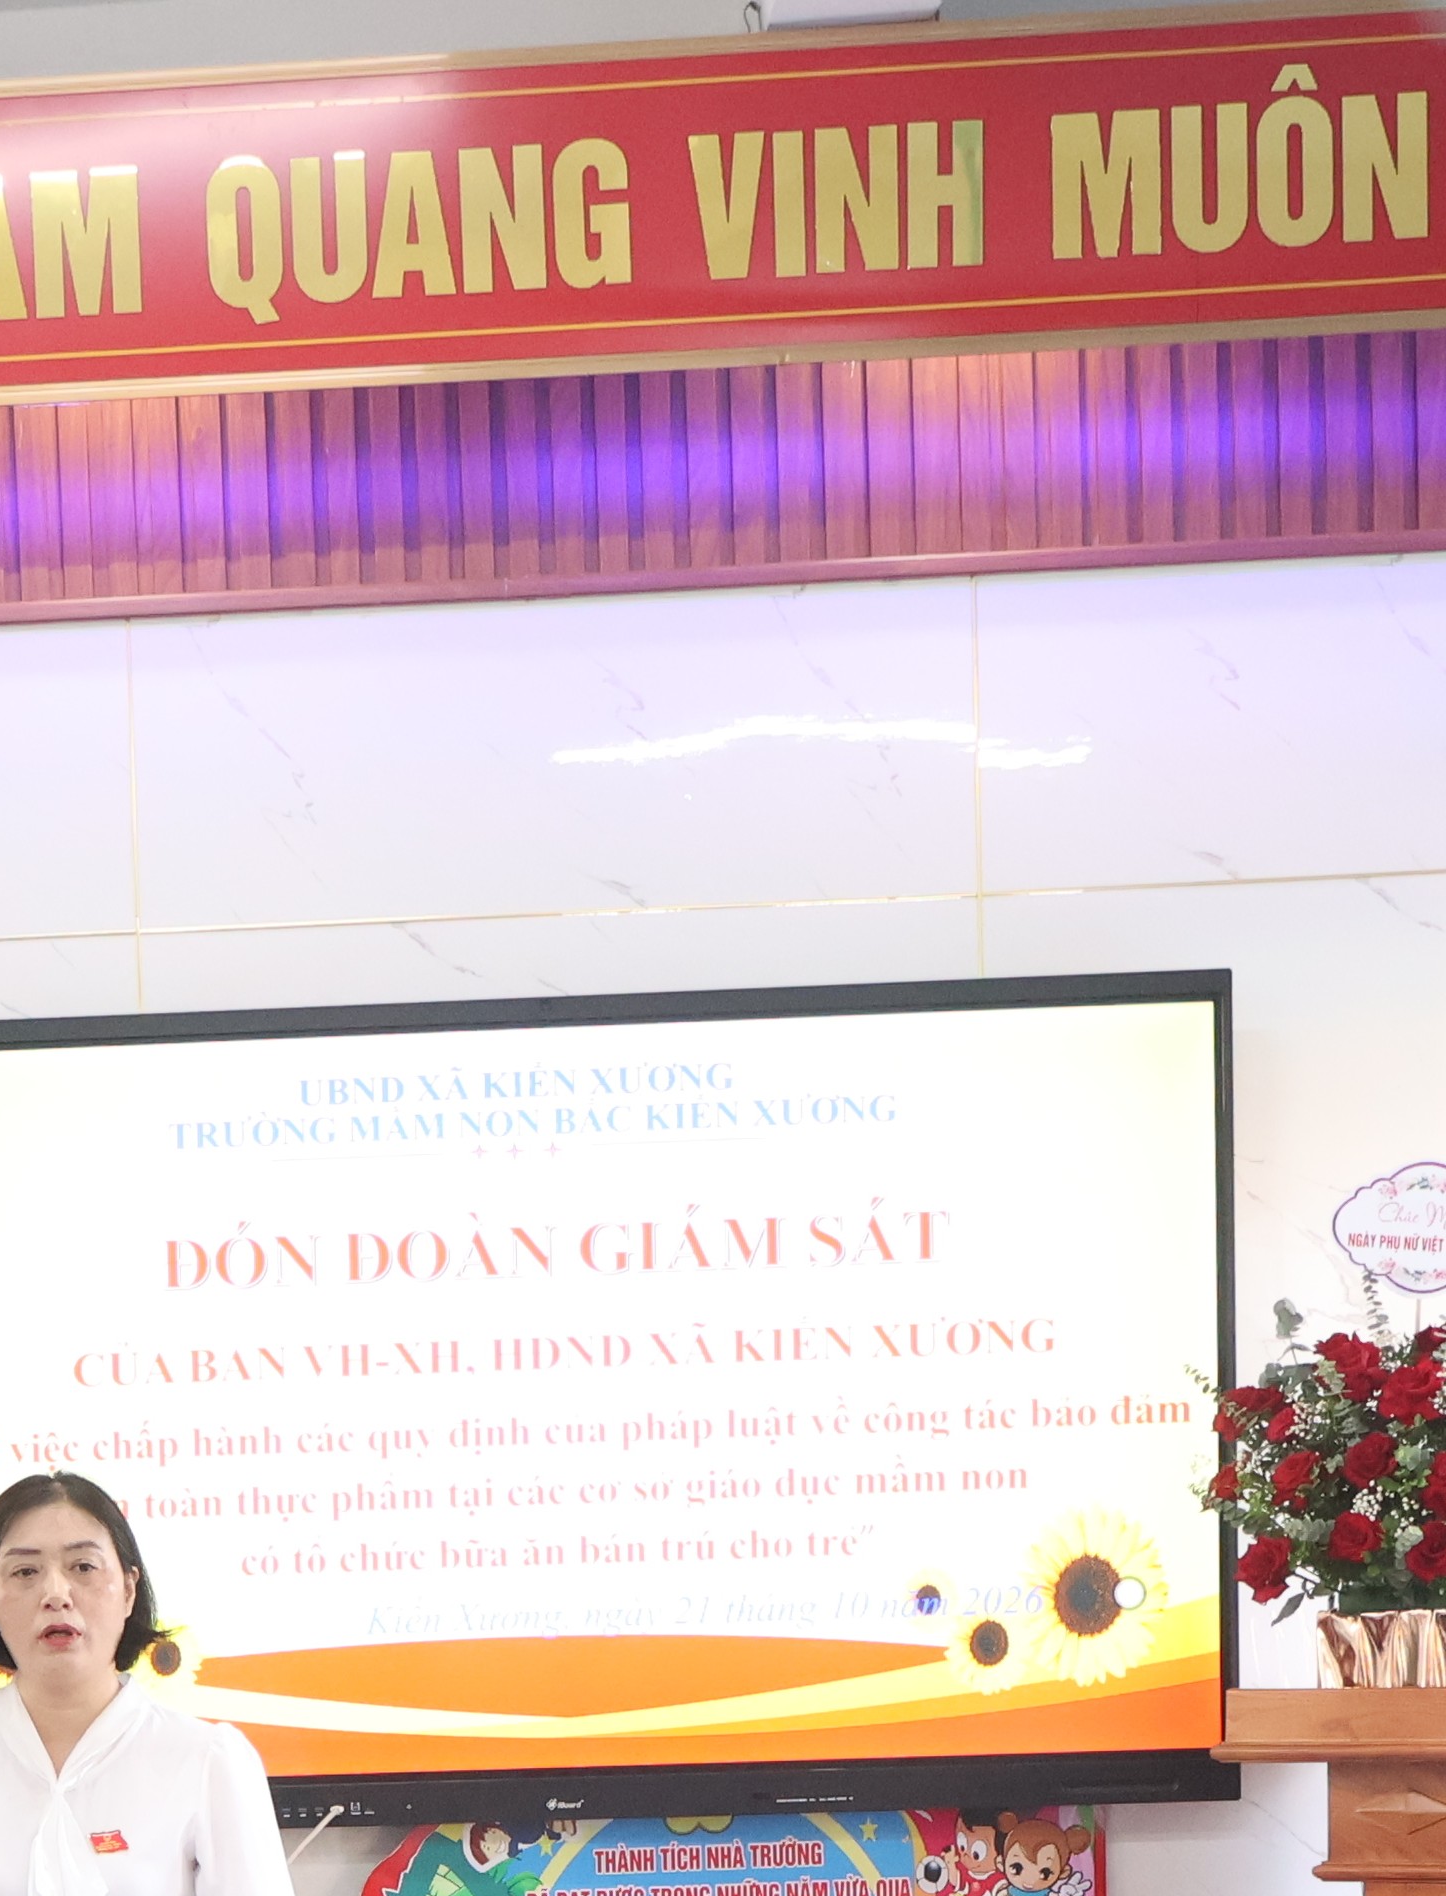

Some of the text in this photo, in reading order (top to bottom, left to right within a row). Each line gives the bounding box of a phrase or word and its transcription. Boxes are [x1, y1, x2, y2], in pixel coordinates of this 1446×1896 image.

[208, 139, 632, 325] QUANG
[689, 120, 983, 282] VINH
[1050, 64, 1429, 262] MUÔN
[300, 1076, 404, 1106] UBND
[417, 1067, 468, 1101] XÃ
[591, 1061, 732, 1094] XƯƠNG
[169, 1111, 335, 1149] TRƯỜNG
[460, 1109, 539, 1138] NON
[753, 1093, 896, 1126] XƯƠNG
[164, 1197, 950, 1291] ĐÓN ĐOÀN GIÁM SÁT
[1348, 1232, 1376, 1249] NGÀY
[1380, 1234, 1400, 1253] PHỤ
[1404, 1232, 1420, 1251] NỮ
[1422, 1236, 1443, 1255] VIỆT
[191, 1347, 285, 1383] BAN
[304, 1340, 476, 1377] VH-XH,
[649, 1322, 715, 1366] XÃ
[872, 1316, 1055, 1357] XƯƠNG
[10, 1432, 79, 1471] việc
[92, 1420, 178, 1466] chấp
[193, 1426, 282, 1457] hành
[296, 1422, 354, 1454] các
[368, 1427, 430, 1459] quy
[448, 1417, 530, 1455] định
[622, 1410, 713, 1451] pháp
[728, 1406, 796, 1445] luật
[811, 1396, 851, 1435] về
[863, 1402, 949, 1440] công
[963, 1399, 1017, 1430] tác
[145, 1487, 222, 1519] toàn
[237, 1487, 316, 1522] thực
[449, 1478, 494, 1516] tại
[507, 1475, 564, 1506] các
[579, 1480, 621, 1505] cơ
[686, 1469, 761, 1508] giáo
[775, 1468, 841, 1505] dục
[856, 1455, 945, 1494] mầm
[962, 1468, 1028, 1491] non
[241, 1544, 279, 1576] có
[340, 1540, 425, 1572] chức
[441, 1539, 508, 1569] bữa
[523, 1538, 564, 1566] ăn
[580, 1533, 646, 1564] bán
[661, 1530, 714, 1562] trú
[730, 1530, 793, 1560] cho
[674, 1597, 709, 1625] 21
[725, 1591, 816, 1630] tháng
[833, 1590, 869, 1619] 10
[881, 1588, 948, 1618] năm
[594, 1838, 823, 1874] THÀNH TÍCH NHÀ TRƯỜNG
